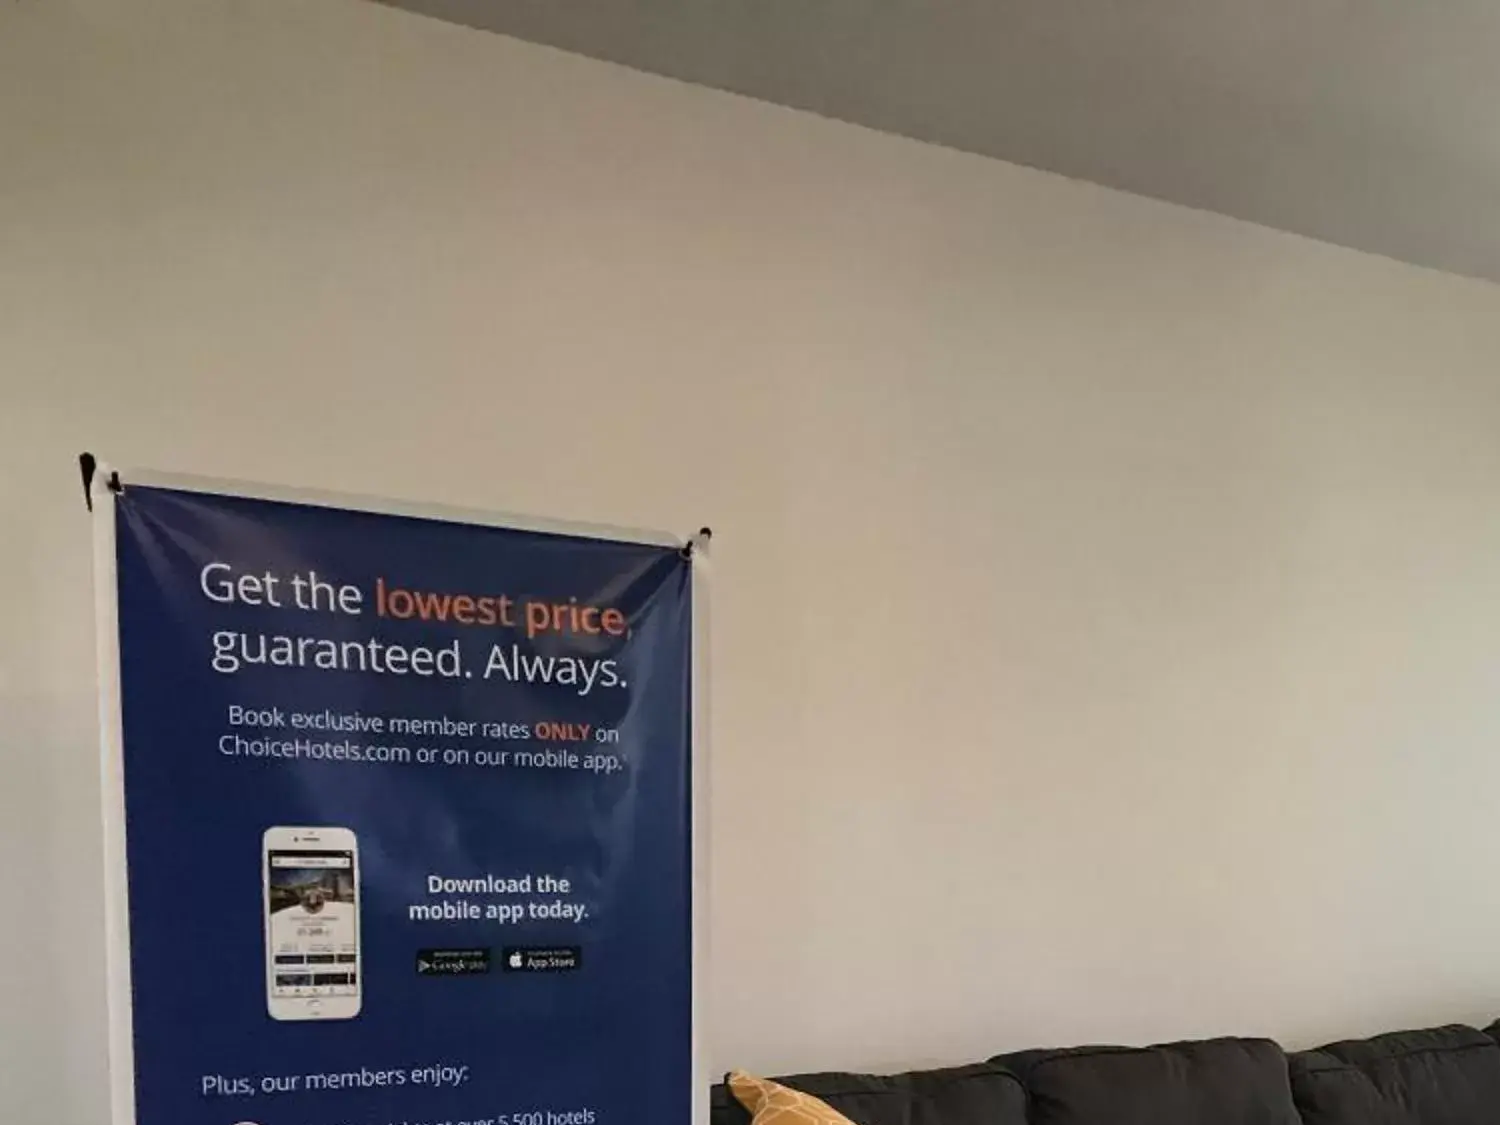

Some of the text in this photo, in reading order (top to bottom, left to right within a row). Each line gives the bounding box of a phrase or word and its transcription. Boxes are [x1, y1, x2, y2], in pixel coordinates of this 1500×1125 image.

[200, 563, 633, 640] Get the lowest price,
[212, 629, 628, 695] guaranteed. Always.
[229, 705, 619, 743] Book exclusive member rates ONLY on
[219, 735, 410, 763] ChoiceHotels.com
[417, 747, 438, 764] or
[443, 748, 469, 766] on
[475, 749, 509, 767] our
[514, 749, 579, 770] mobile
[427, 873, 571, 894] Download the
[409, 900, 590, 924] mobile app today.
[202, 1063, 470, 1097] Plus, our members enjoy:
